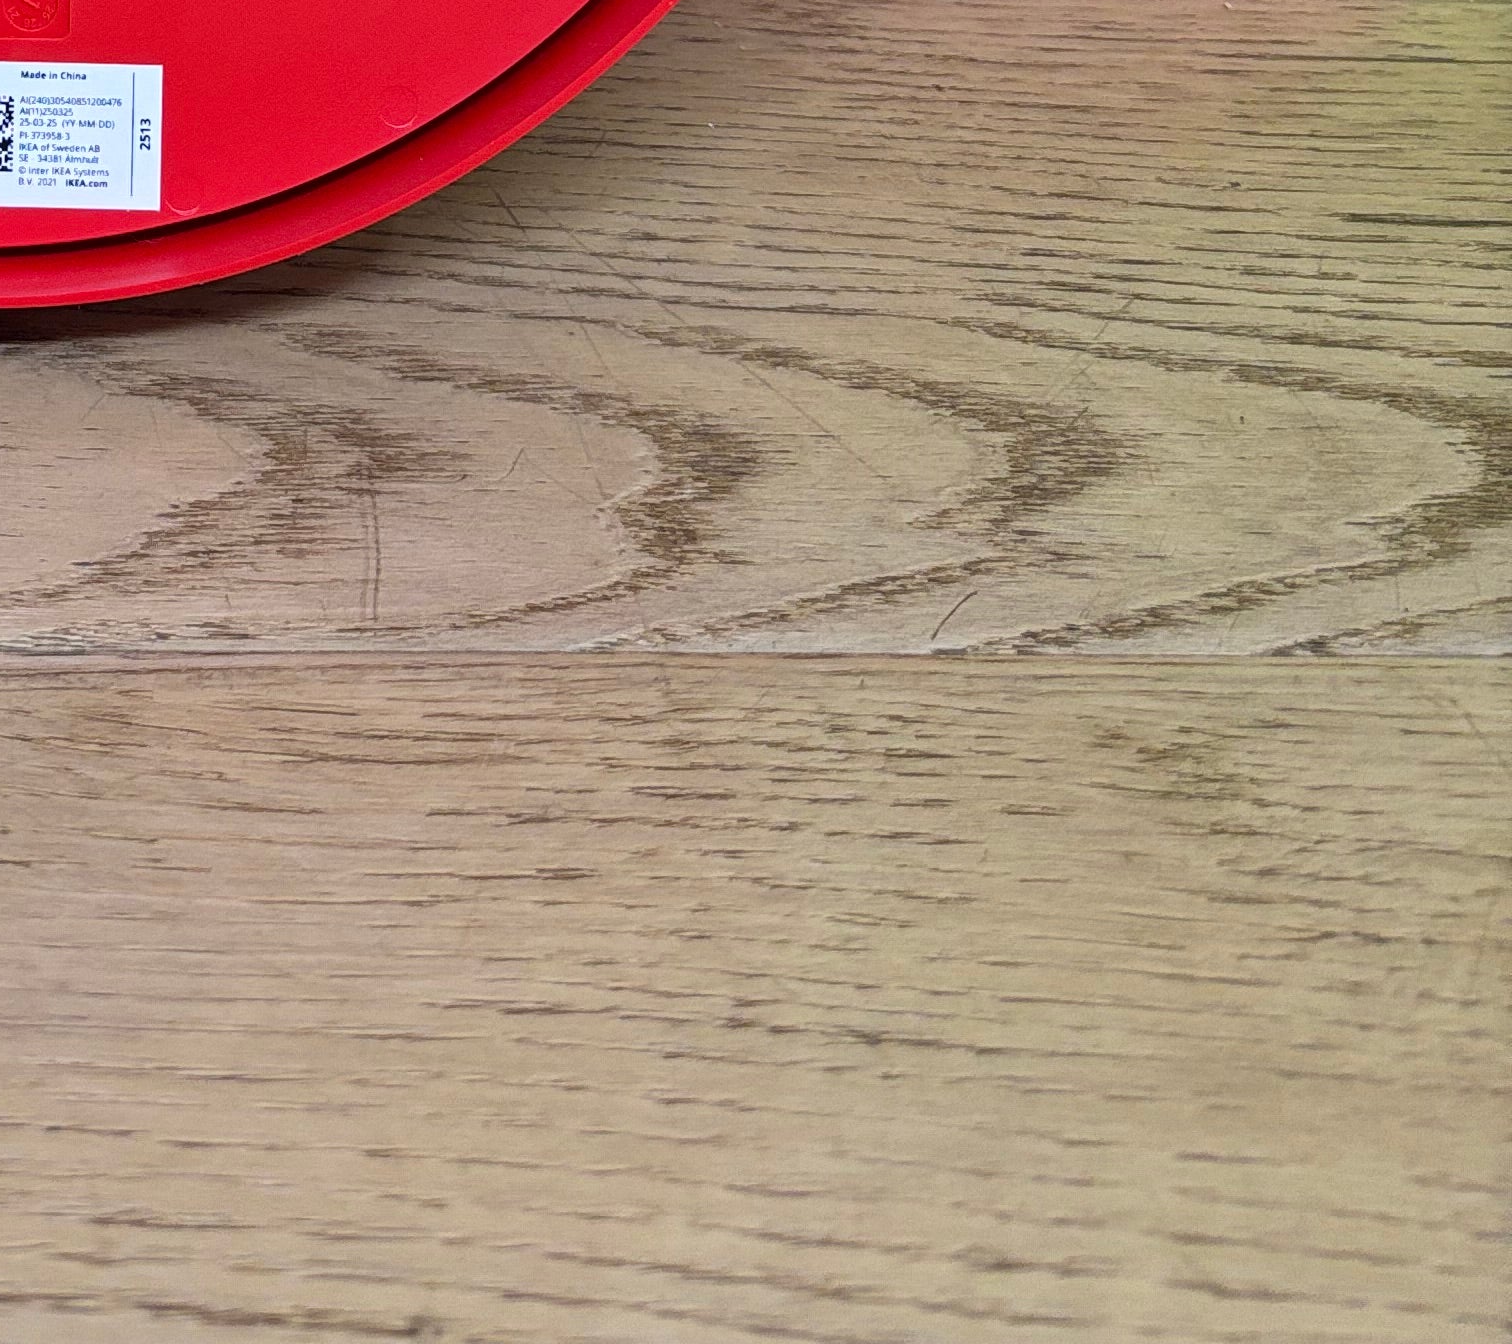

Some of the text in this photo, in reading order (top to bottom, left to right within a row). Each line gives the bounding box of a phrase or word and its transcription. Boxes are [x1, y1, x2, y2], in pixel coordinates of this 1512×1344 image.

[20, 71, 87, 80] Made in China
[139, 118, 151, 151] 2513
[19, 143, 101, 153] IKEA of Sweden AB
[29, 166, 49, 175] Inter
[52, 167, 71, 175] IKEA
[74, 168, 109, 177] Systems
[38, 178, 56, 186] 2021
[65, 179, 108, 188] IKEA.com
